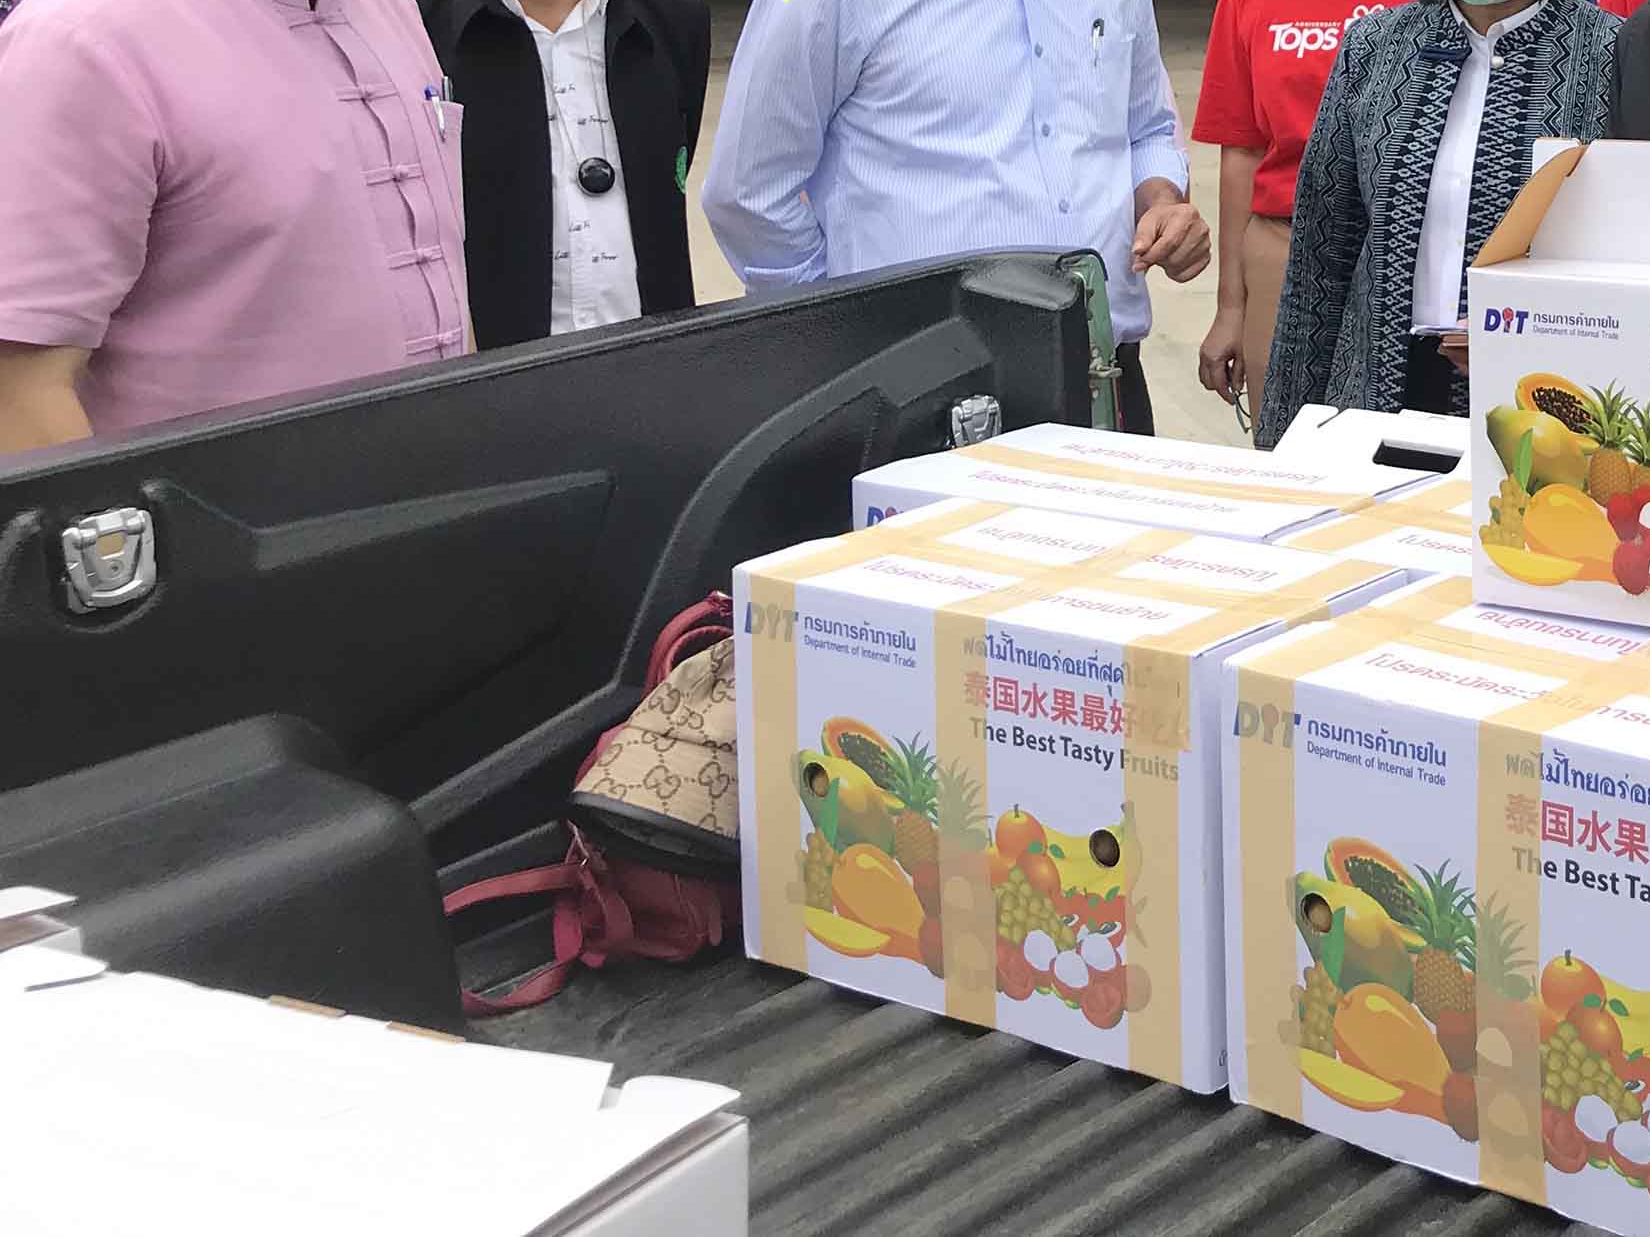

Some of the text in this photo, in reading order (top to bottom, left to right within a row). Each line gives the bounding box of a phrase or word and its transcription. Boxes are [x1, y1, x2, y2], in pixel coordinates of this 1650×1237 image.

[1268, 22, 1339, 59] Tops
[1533, 312, 1620, 330] กรมการค้าภายใน
[1533, 325, 1568, 336] Department
[1569, 328, 1576, 336] of
[804, 615, 917, 651] กรมการค้าภายใน
[804, 634, 917, 668] Department of Internal Trade
[970, 717, 1180, 781] The Best Tasty Fruits
[1307, 719, 1448, 767] กรมการค้าภายใน
[1307, 740, 1446, 787] Department of Internal Trade
[1511, 845, 1558, 879] The
[1564, 858, 1620, 896] Best
